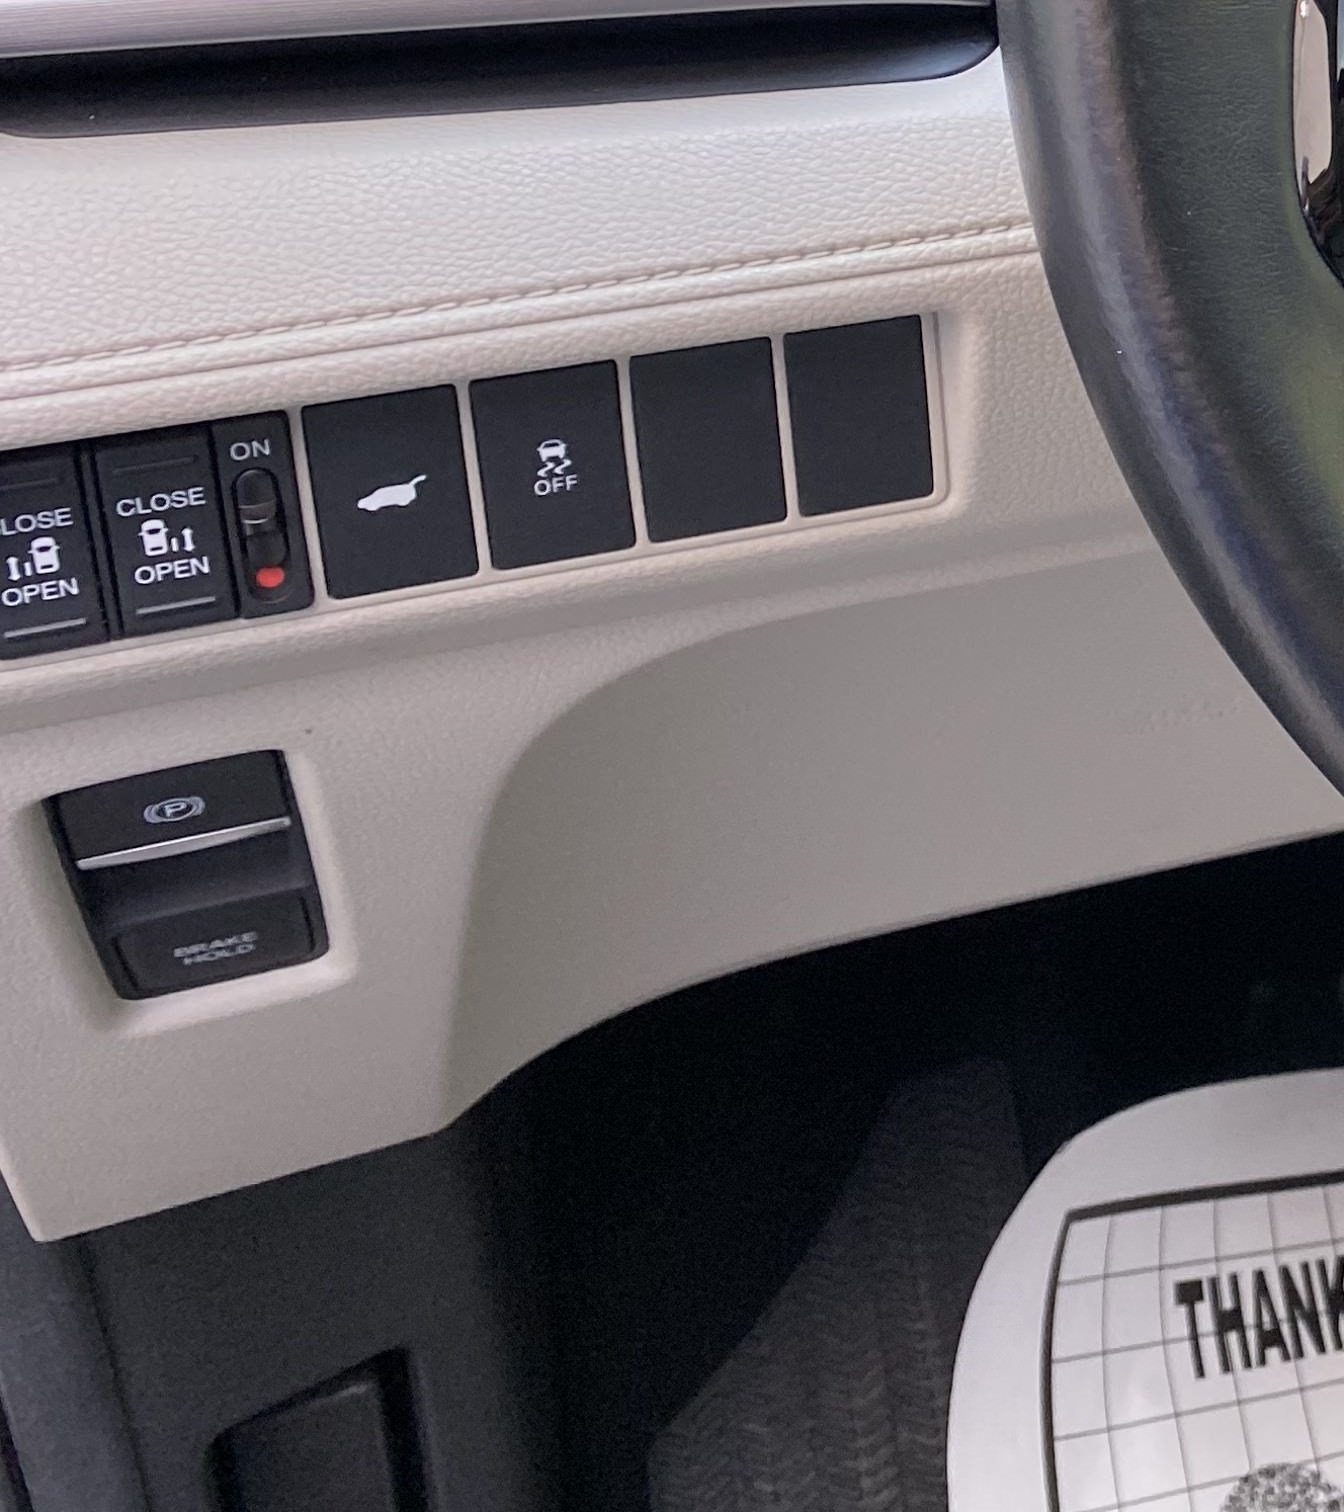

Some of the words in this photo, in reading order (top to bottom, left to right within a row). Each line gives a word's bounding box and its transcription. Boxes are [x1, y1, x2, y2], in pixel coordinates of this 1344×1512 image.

[229, 438, 271, 461] ON
[534, 474, 578, 496] OFF
[116, 486, 206, 517] CLOSE
[0, 507, 74, 536] LOSE
[134, 556, 210, 585] OPEN
[1, 577, 80, 607] OPEN
